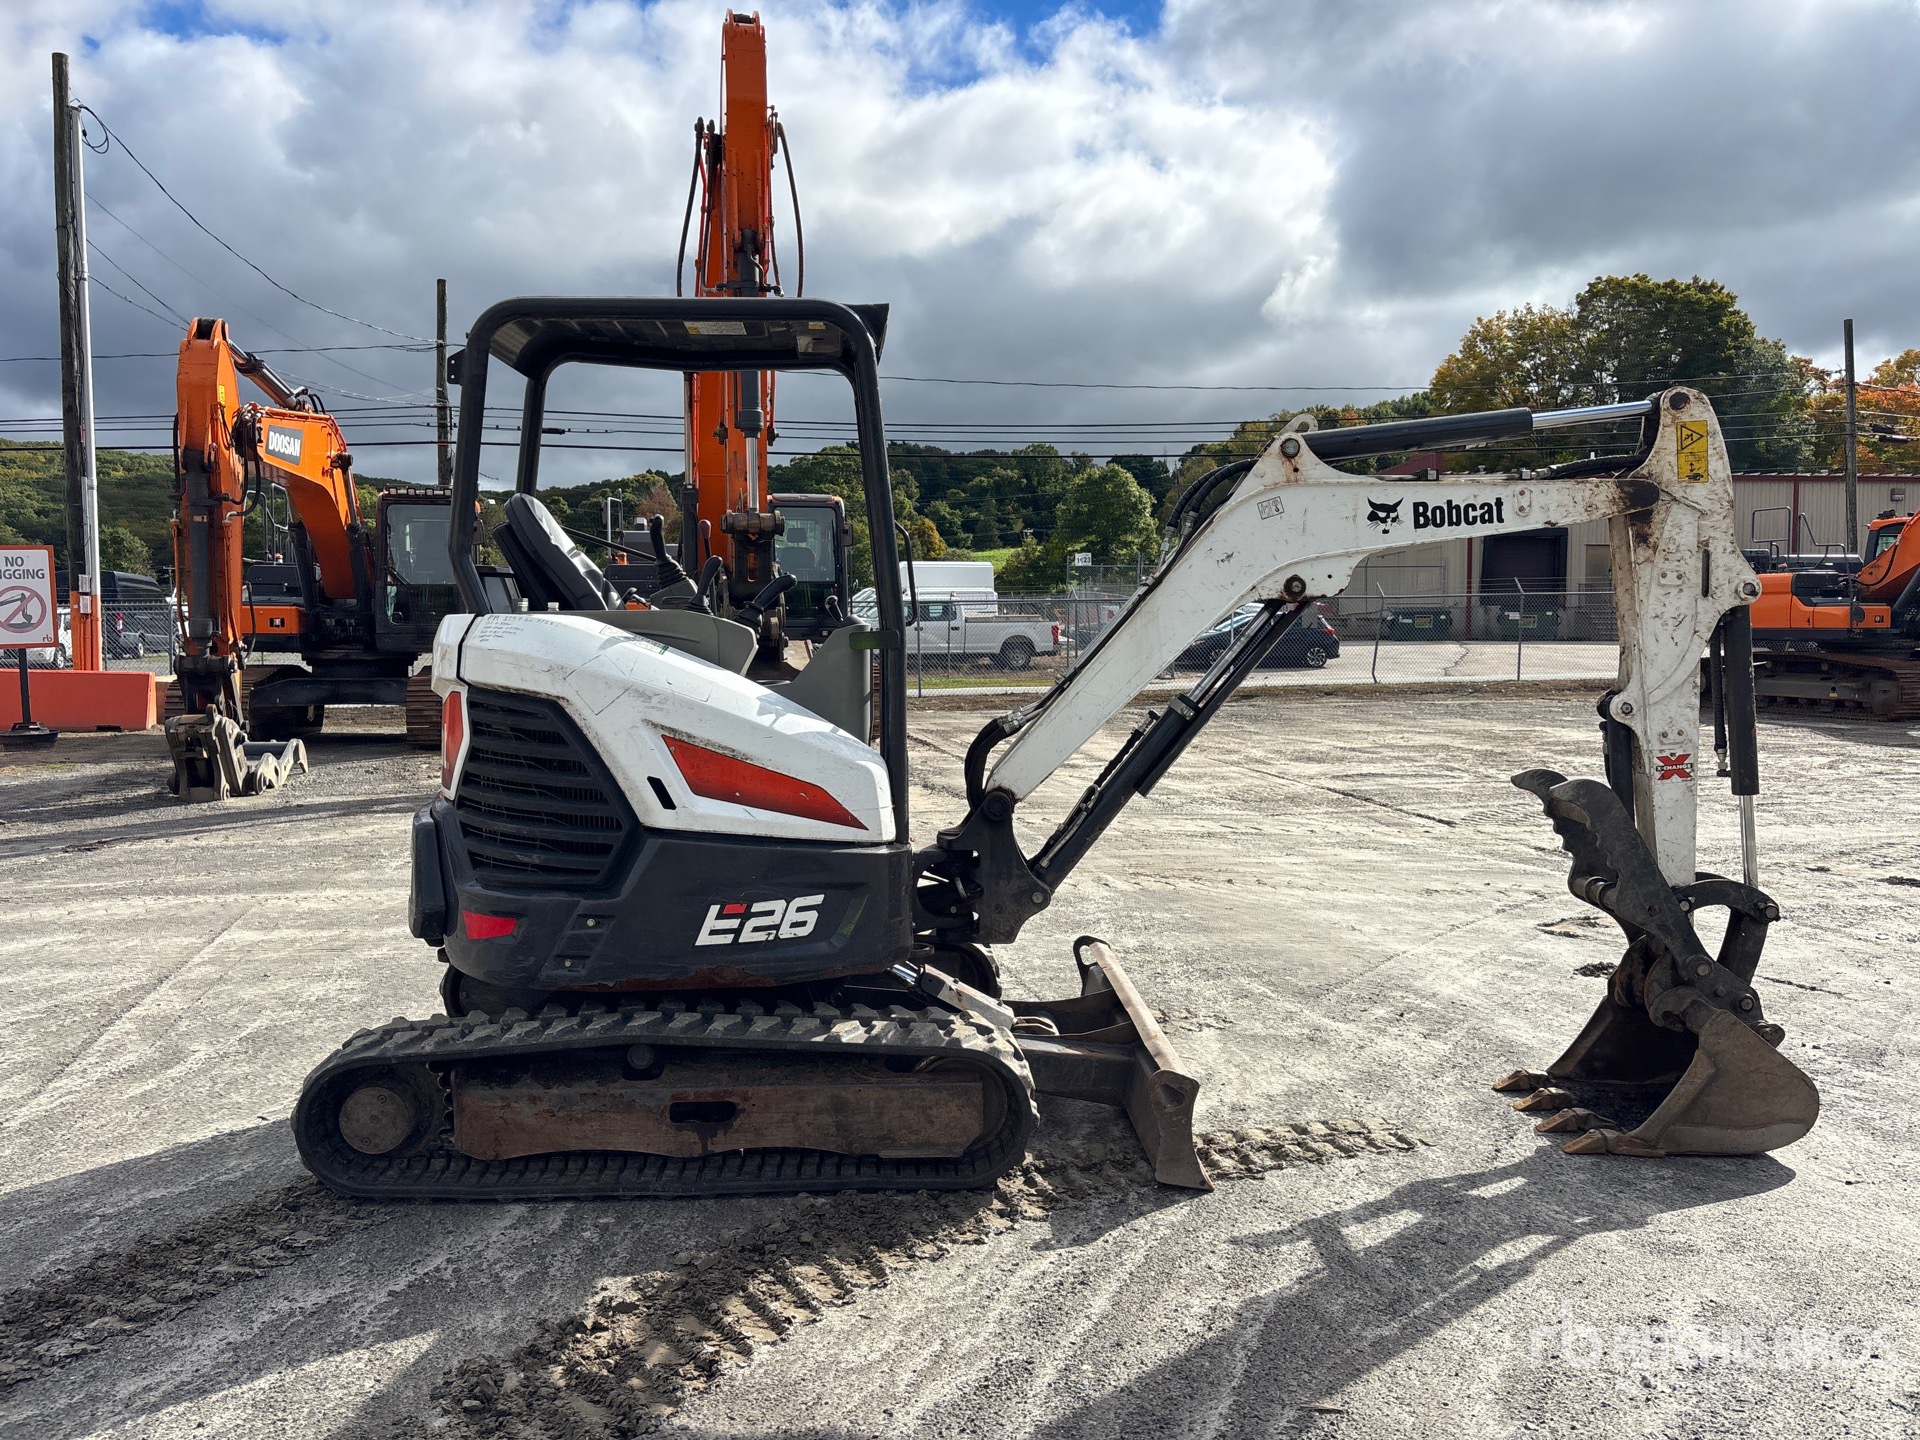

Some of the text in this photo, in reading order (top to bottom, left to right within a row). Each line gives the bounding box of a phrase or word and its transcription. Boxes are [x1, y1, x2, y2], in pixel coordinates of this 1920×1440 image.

[268, 430, 301, 457] DOOSAN
[1412, 496, 1505, 530] Bobcat
[5, 556, 24, 567] NO
[0, 568, 45, 580] IGGING
[42, 634, 53, 643] rb
[694, 894, 825, 946] E26
